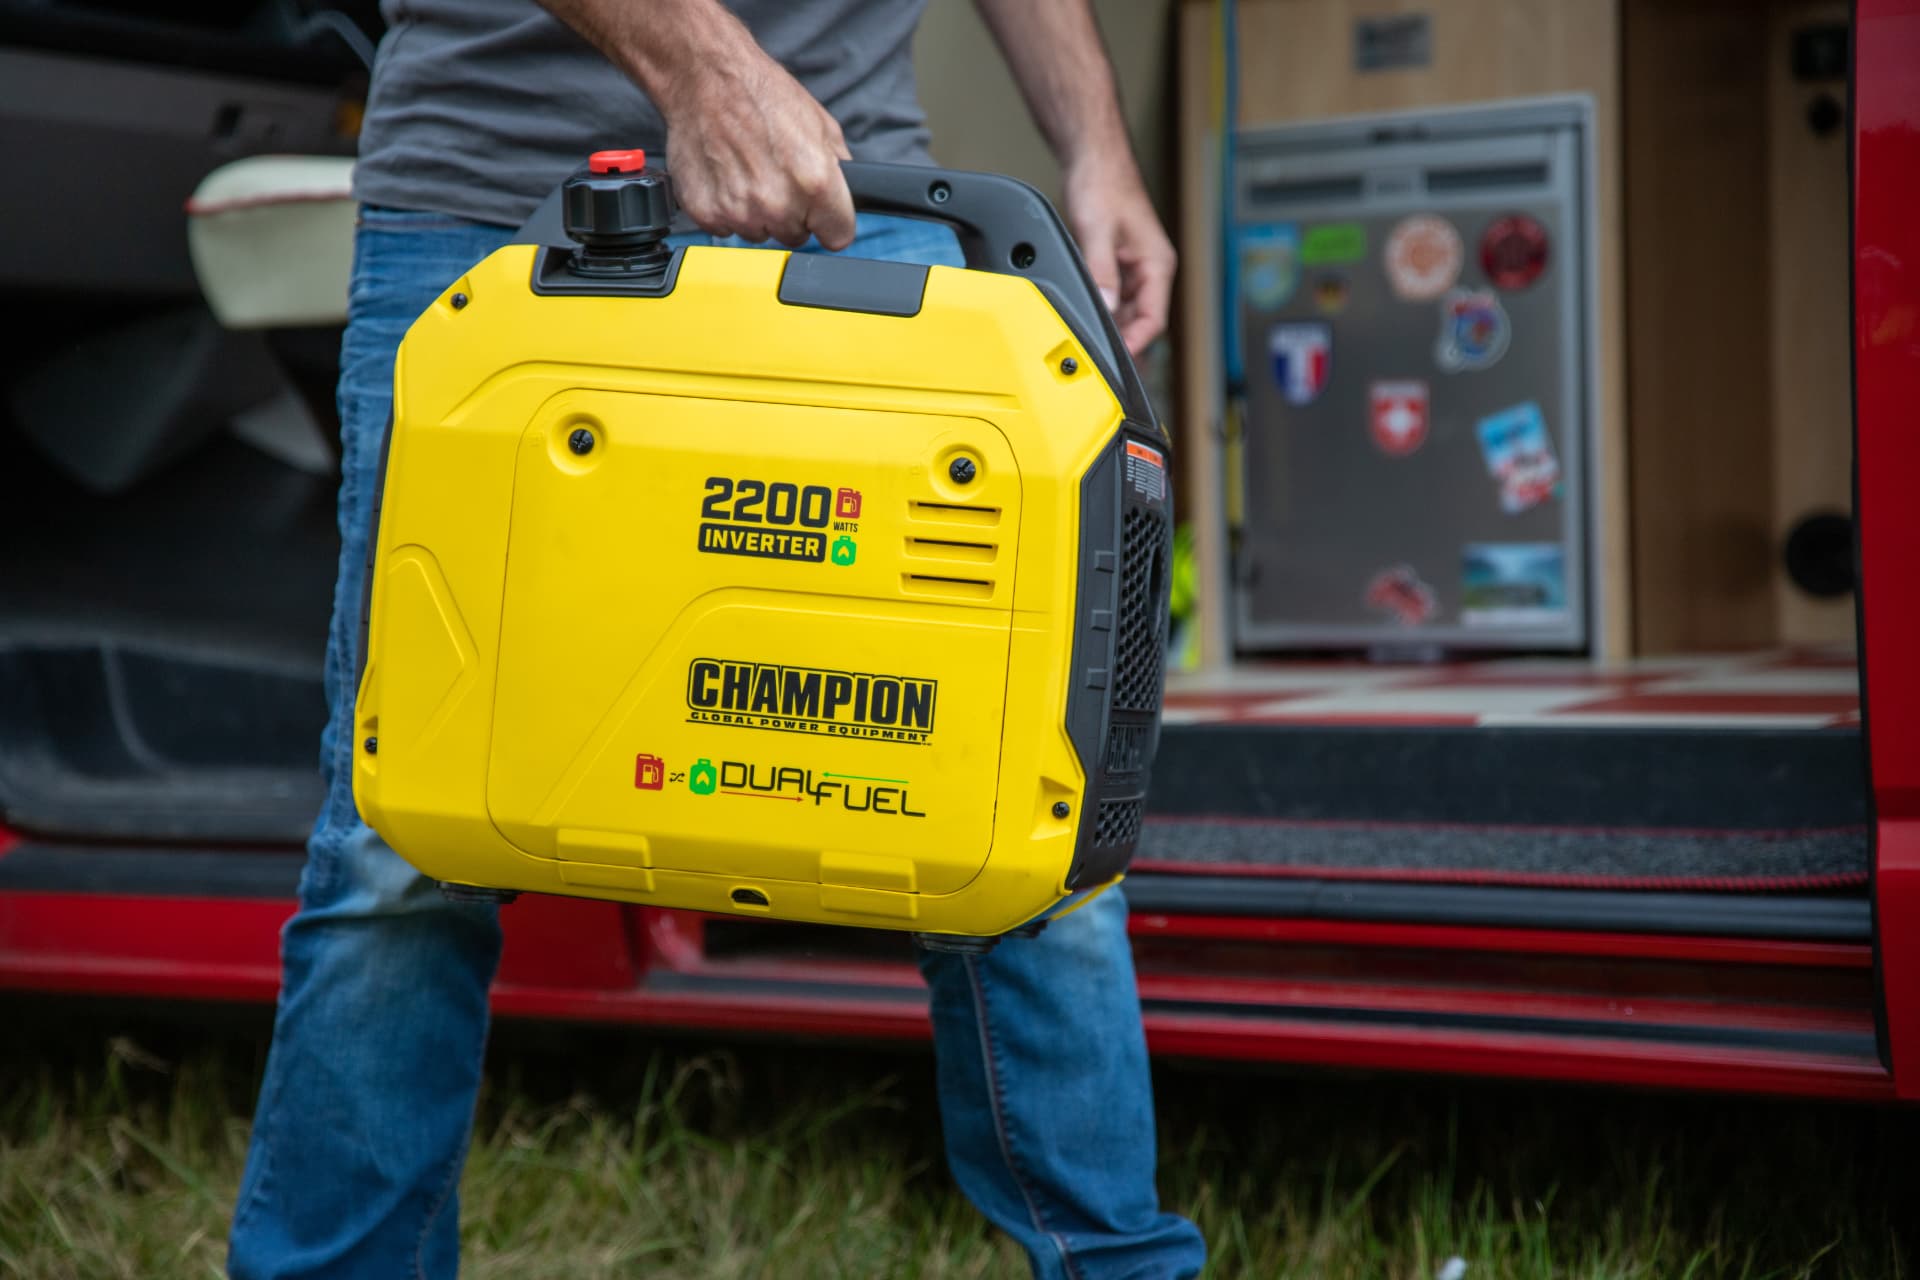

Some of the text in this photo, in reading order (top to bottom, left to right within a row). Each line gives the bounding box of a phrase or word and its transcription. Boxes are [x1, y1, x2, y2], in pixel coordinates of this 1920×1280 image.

[701, 476, 832, 528] 2200
[704, 528, 820, 557] INVERTER
[833, 522, 858, 533] WATTS
[691, 662, 933, 729] CHAMPION
[691, 711, 928, 742] GLOBAL POWER EQUIPMENT
